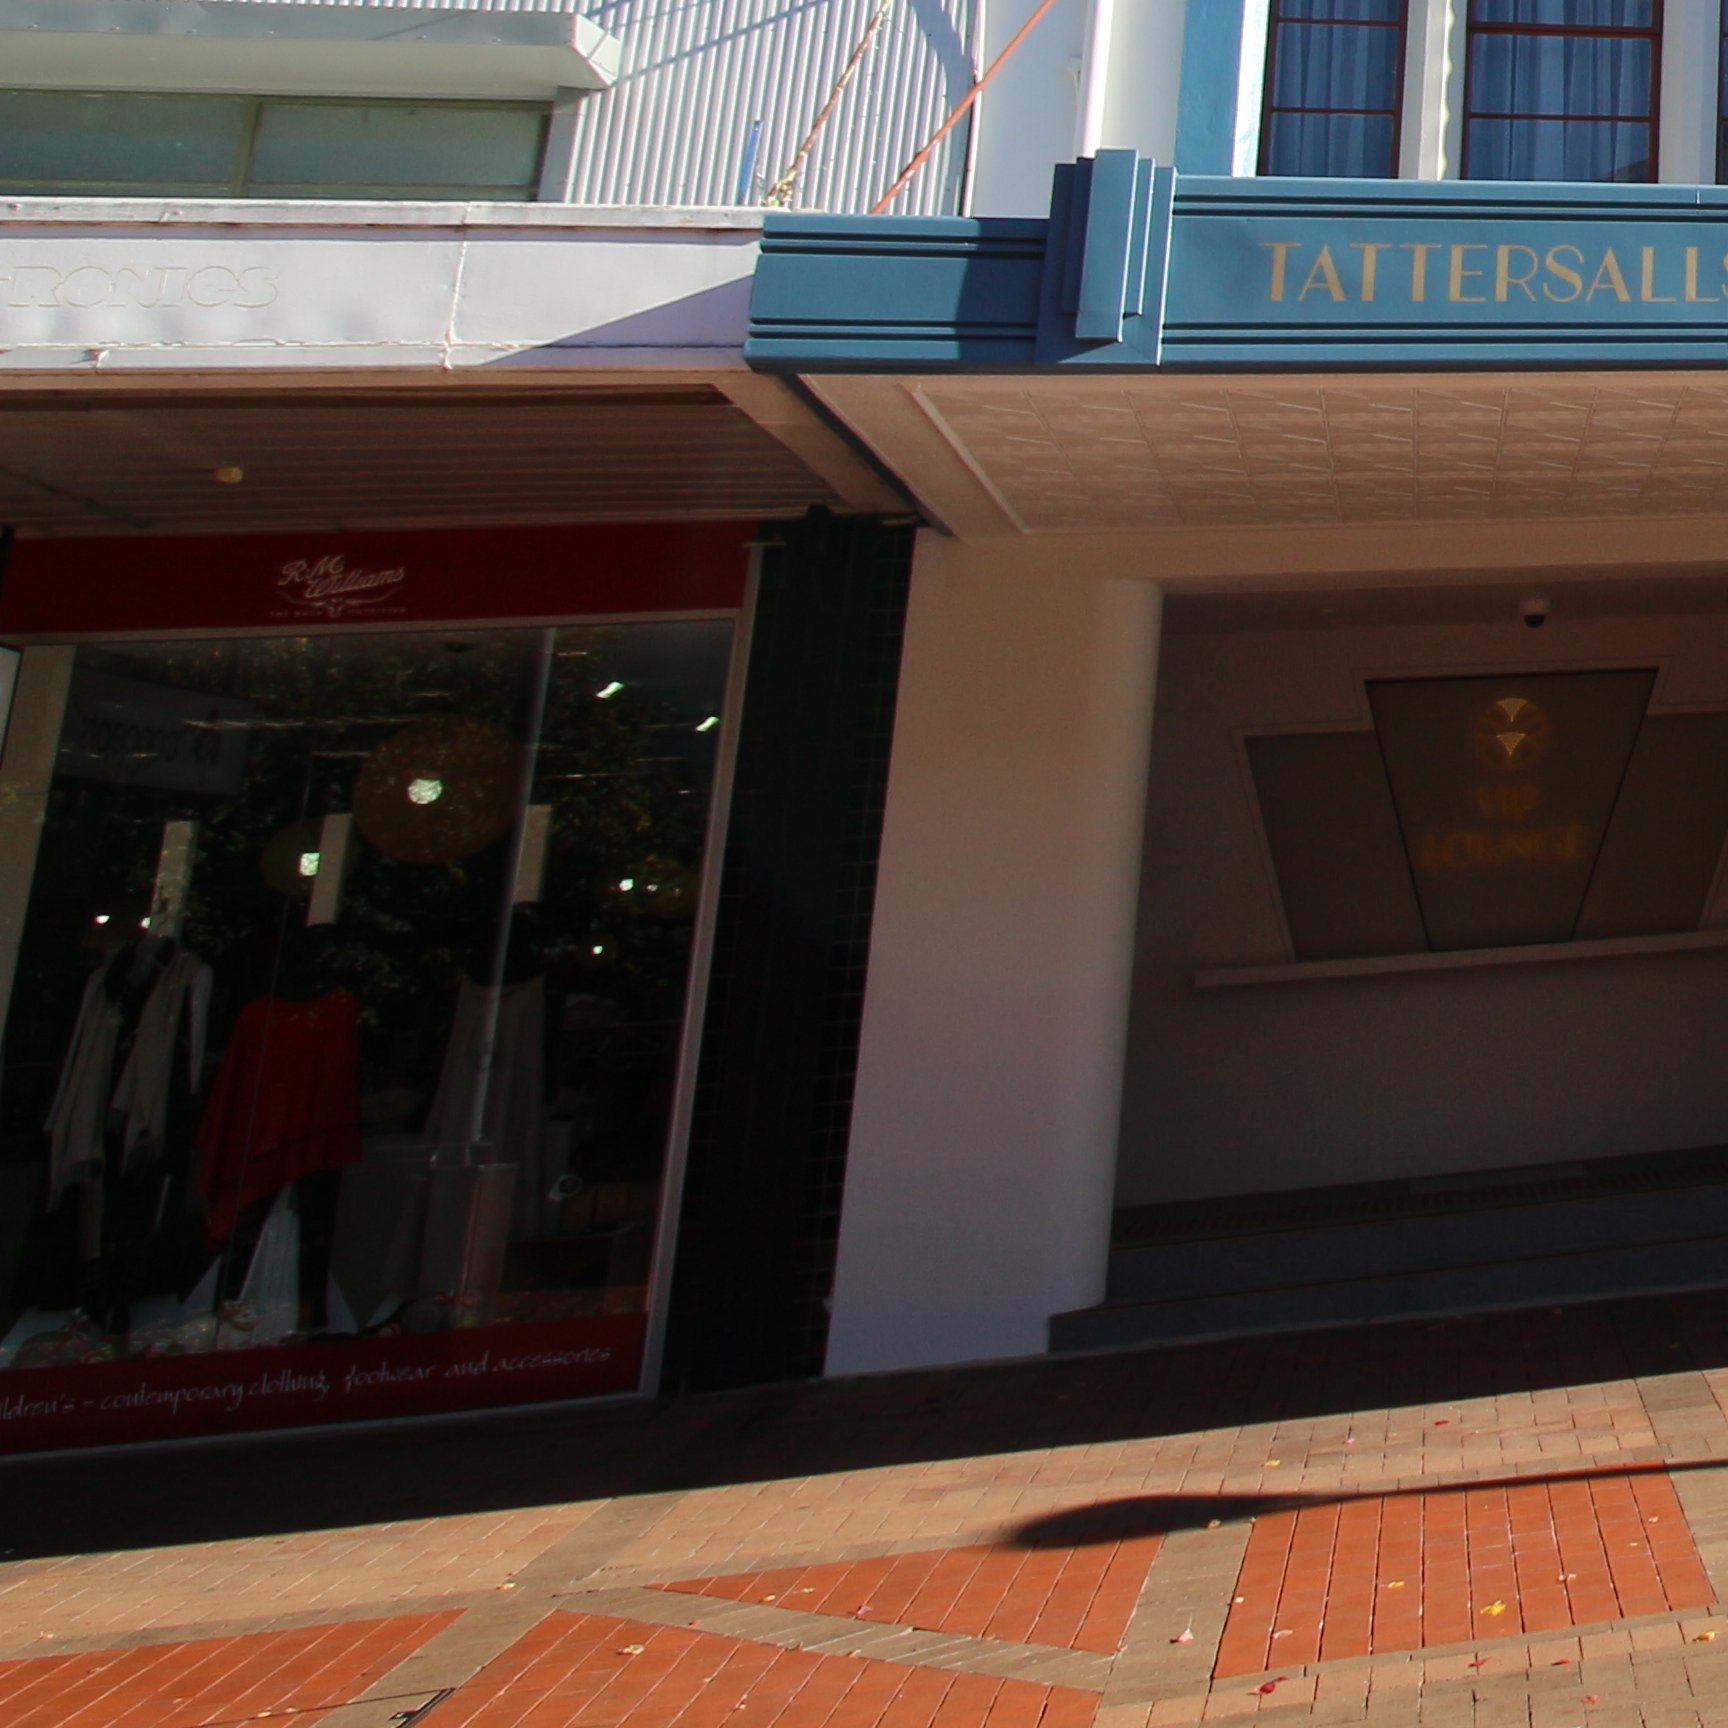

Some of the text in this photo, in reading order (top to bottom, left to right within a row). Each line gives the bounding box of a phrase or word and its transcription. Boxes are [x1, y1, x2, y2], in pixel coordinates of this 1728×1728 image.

[0, 265, 280, 309] RONICS
[304, 567, 406, 599] Williams
[0, 1393, 76, 1420] ldren's
[100, 1382, 244, 1416] contemporary
[344, 1359, 437, 1393] footwear
[444, 1350, 490, 1377] and
[492, 1346, 612, 1372] accessories
